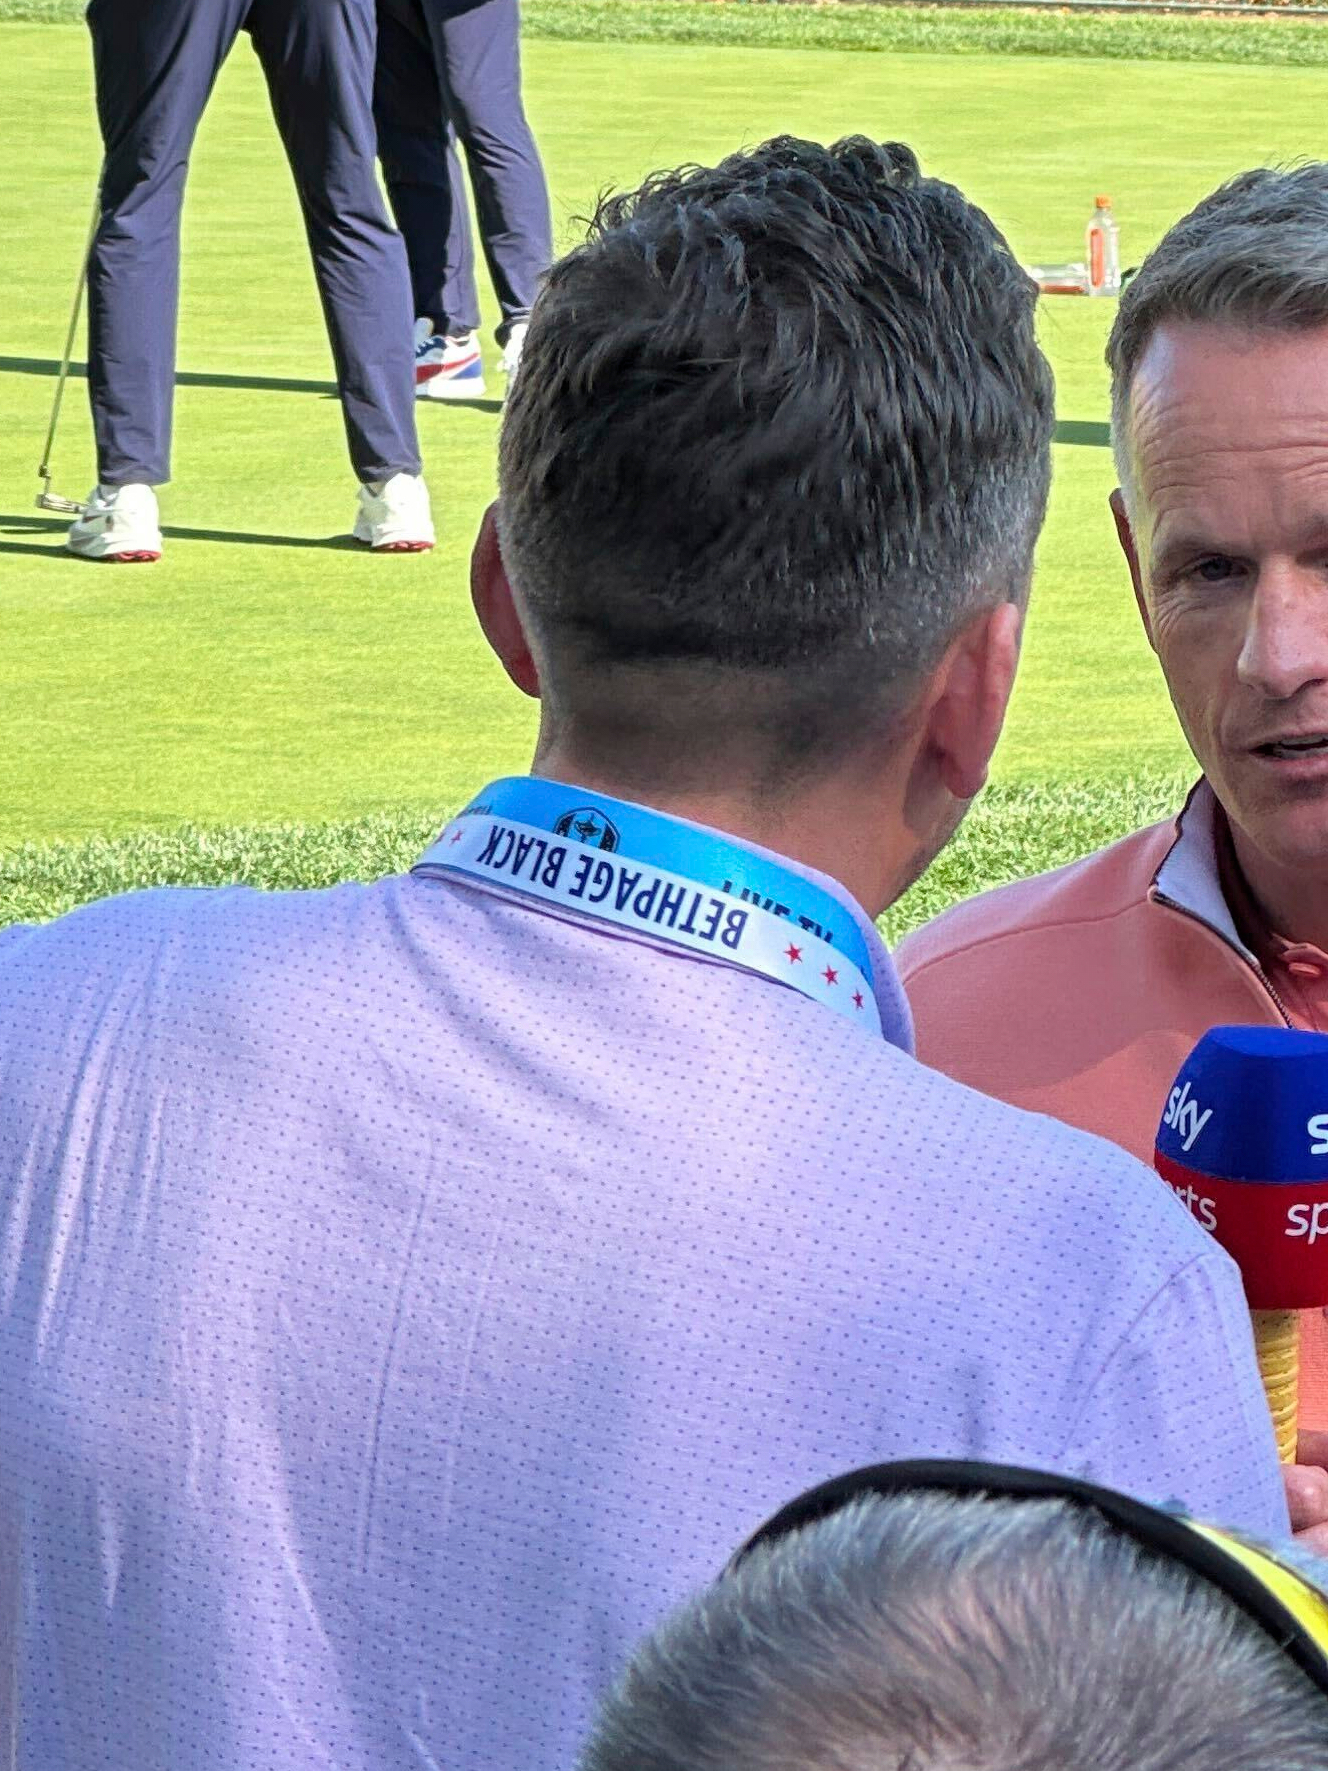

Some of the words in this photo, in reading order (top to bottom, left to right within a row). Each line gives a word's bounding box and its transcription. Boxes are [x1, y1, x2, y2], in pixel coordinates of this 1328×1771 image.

[476, 823, 568, 889] BLACK
[568, 853, 749, 950] BETHPAGE
[1163, 1081, 1213, 1151] sky
